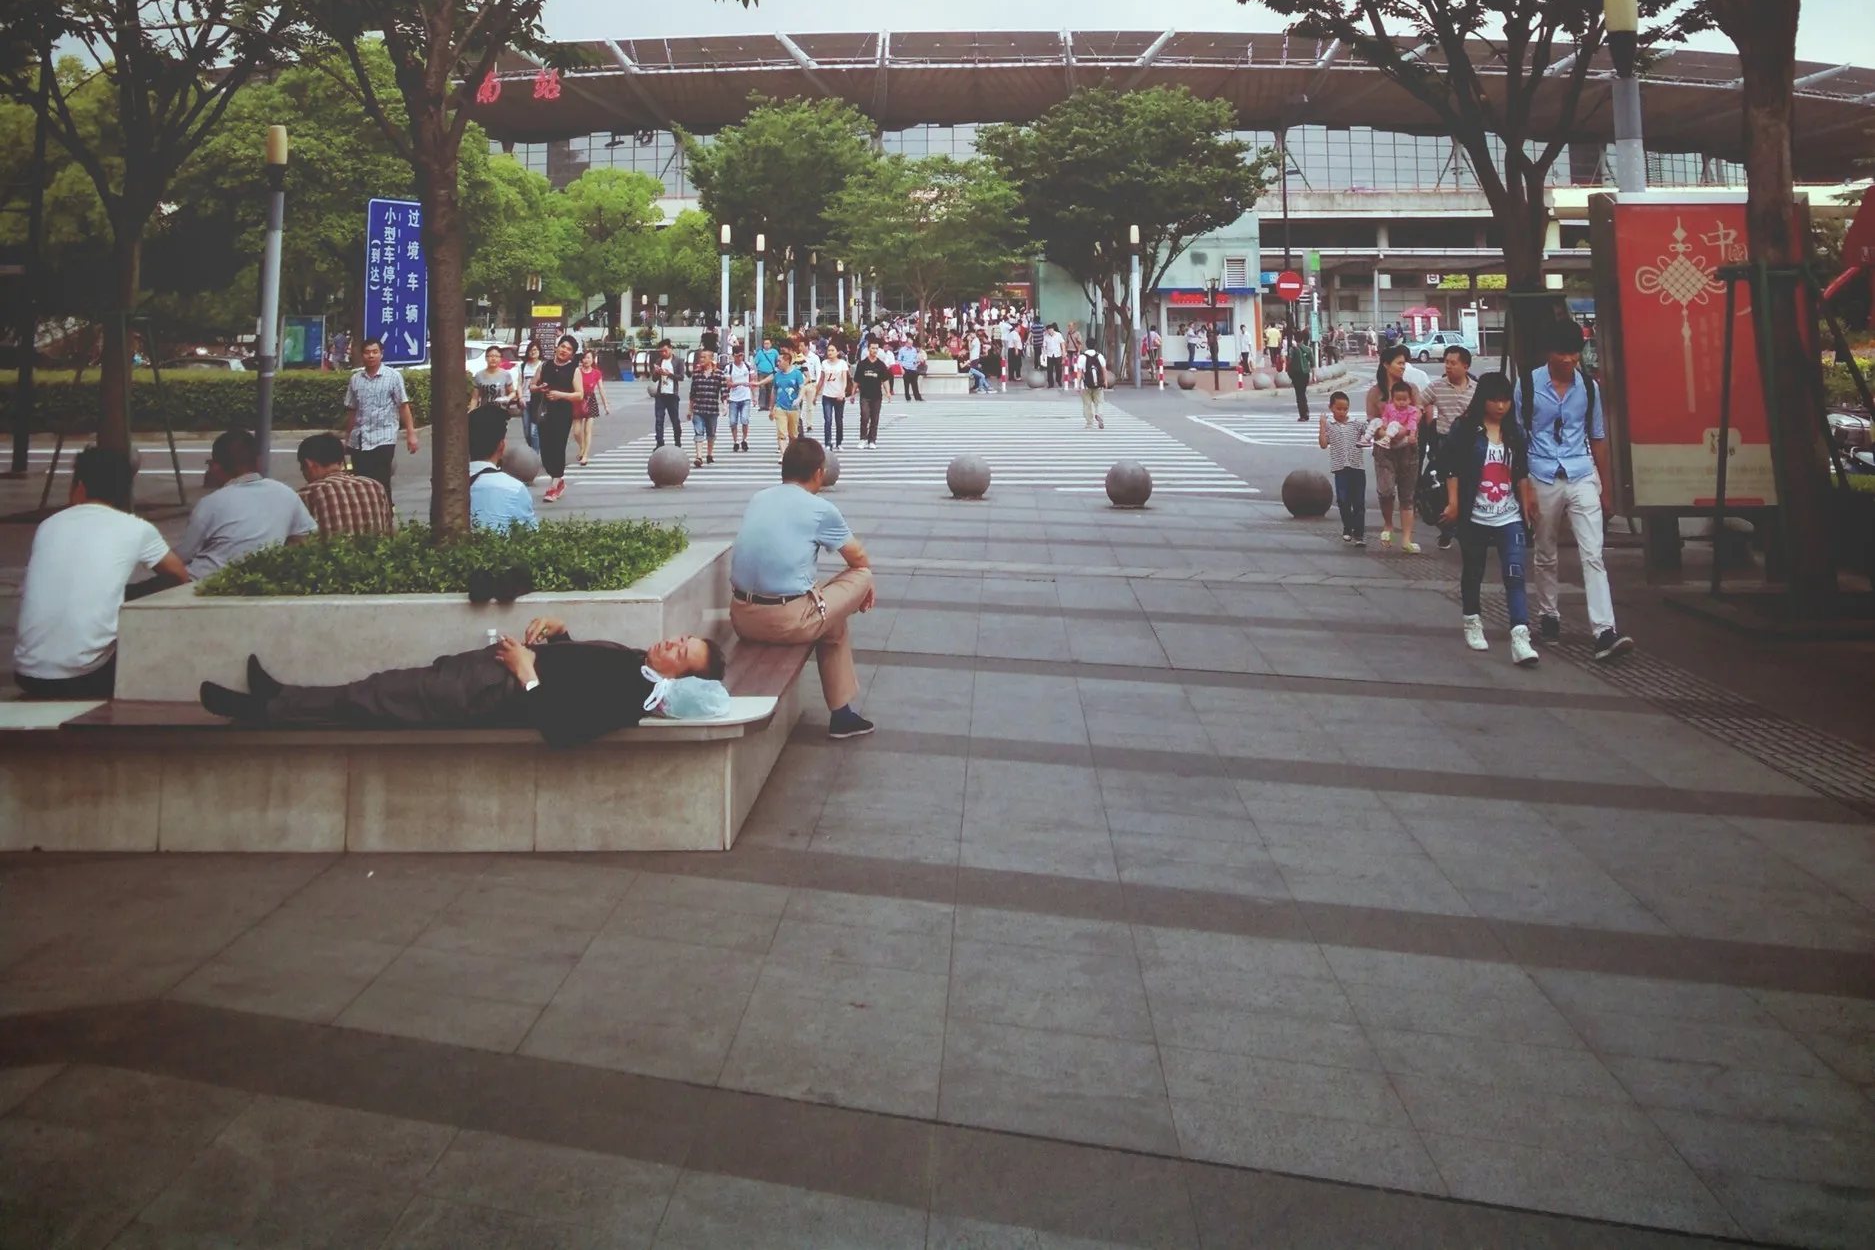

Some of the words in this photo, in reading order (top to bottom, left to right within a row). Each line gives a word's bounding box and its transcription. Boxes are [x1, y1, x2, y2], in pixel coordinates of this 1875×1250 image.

[381, 206, 397, 325] 小型车停车库
[405, 209, 420, 324] 过境车辆
